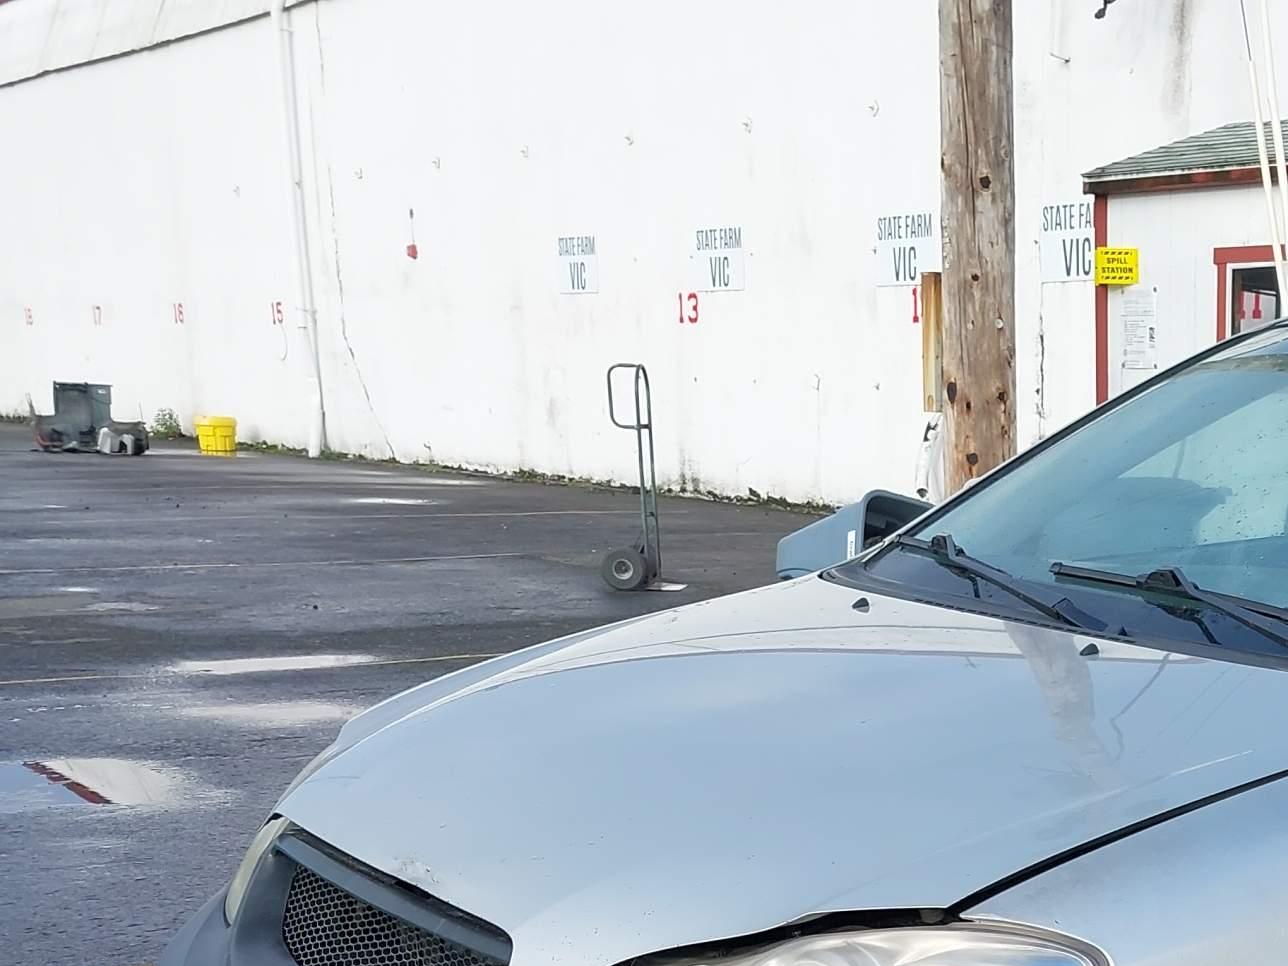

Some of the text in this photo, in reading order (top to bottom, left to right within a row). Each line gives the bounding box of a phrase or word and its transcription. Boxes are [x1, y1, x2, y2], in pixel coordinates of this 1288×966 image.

[877, 213, 932, 241] STATE FARM
[1042, 202, 1093, 232] STATE FA
[558, 235, 596, 256] STATE FARM
[696, 227, 742, 251] STATE FARM
[893, 246, 917, 282] VIC
[1062, 237, 1092, 277] VIC
[1101, 266, 1134, 274] STATION
[1106, 257, 1129, 265] SPILL
[569, 261, 587, 290] VIC
[710, 255, 730, 288] VIC
[271, 301, 284, 325] 15
[678, 292, 699, 324] 13
